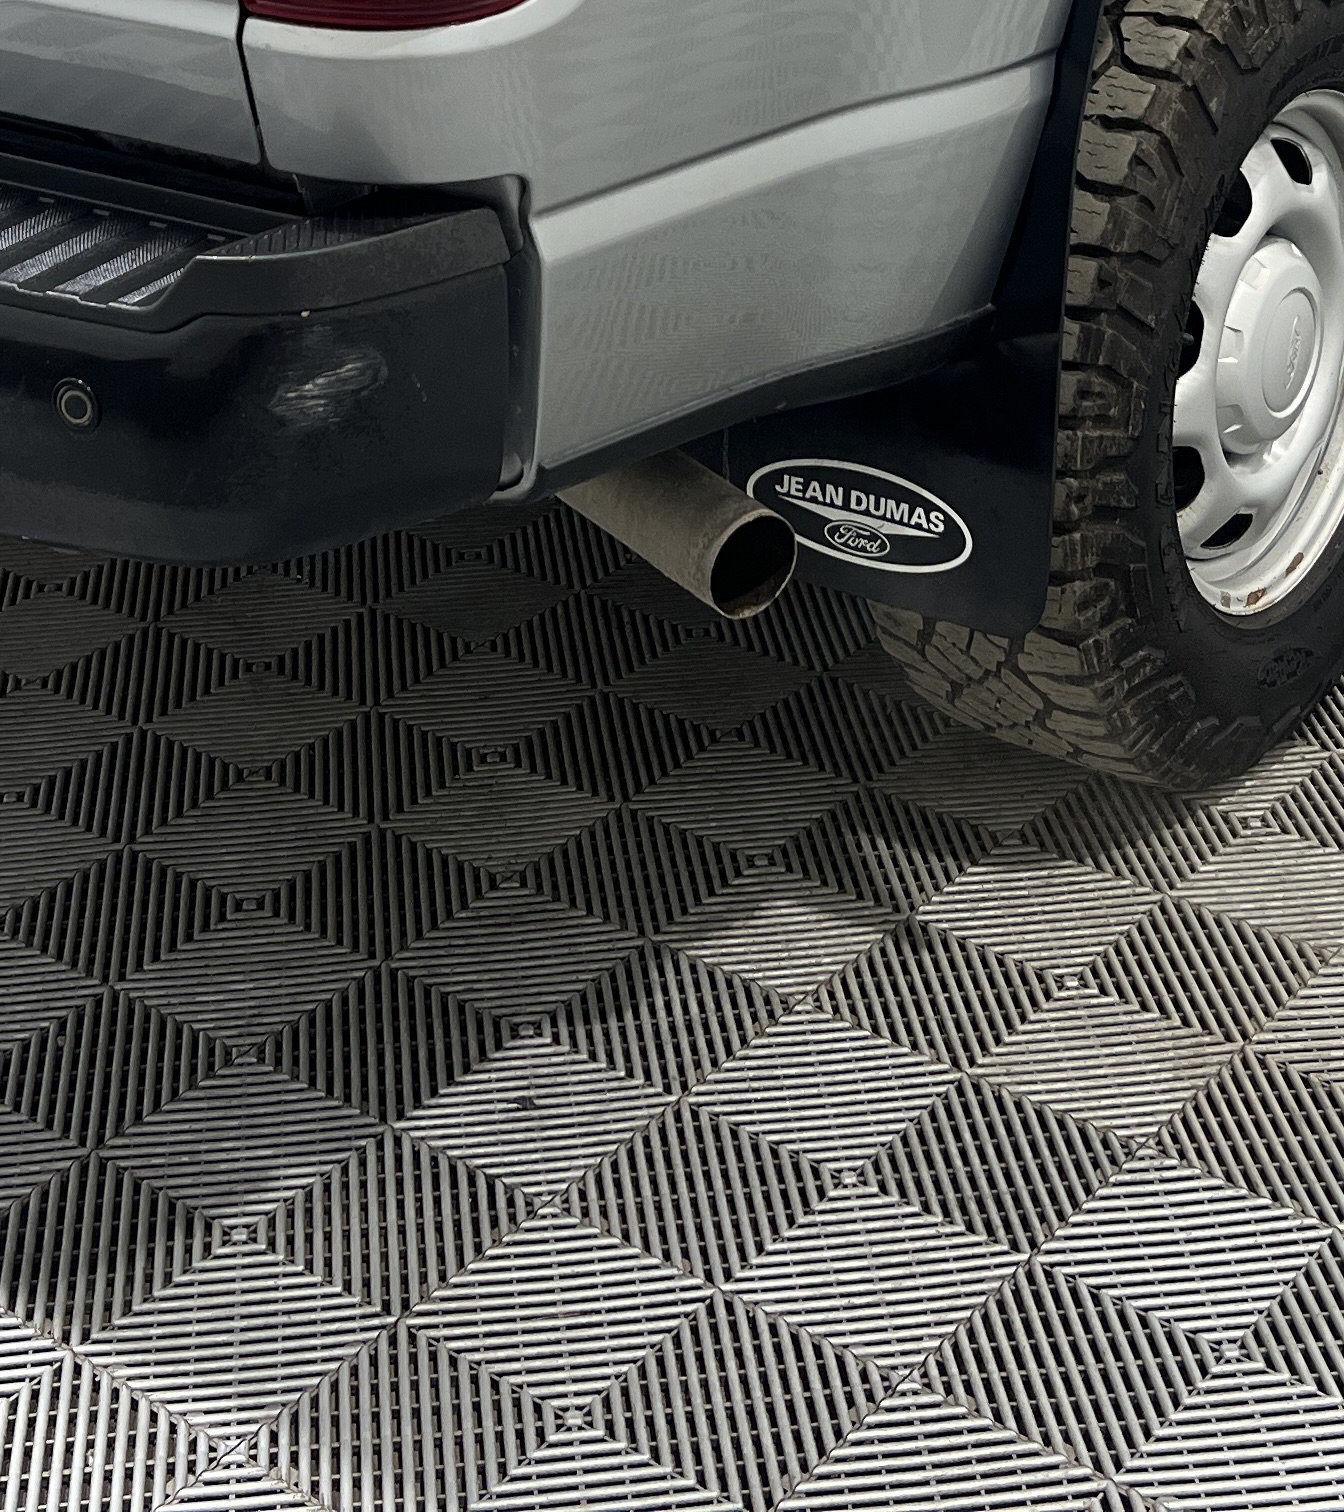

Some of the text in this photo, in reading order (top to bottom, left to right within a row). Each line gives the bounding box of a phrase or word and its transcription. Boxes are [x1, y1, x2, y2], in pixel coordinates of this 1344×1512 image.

[774, 474, 945, 533] JEAN DUMAS
[834, 524, 884, 554] Ford
